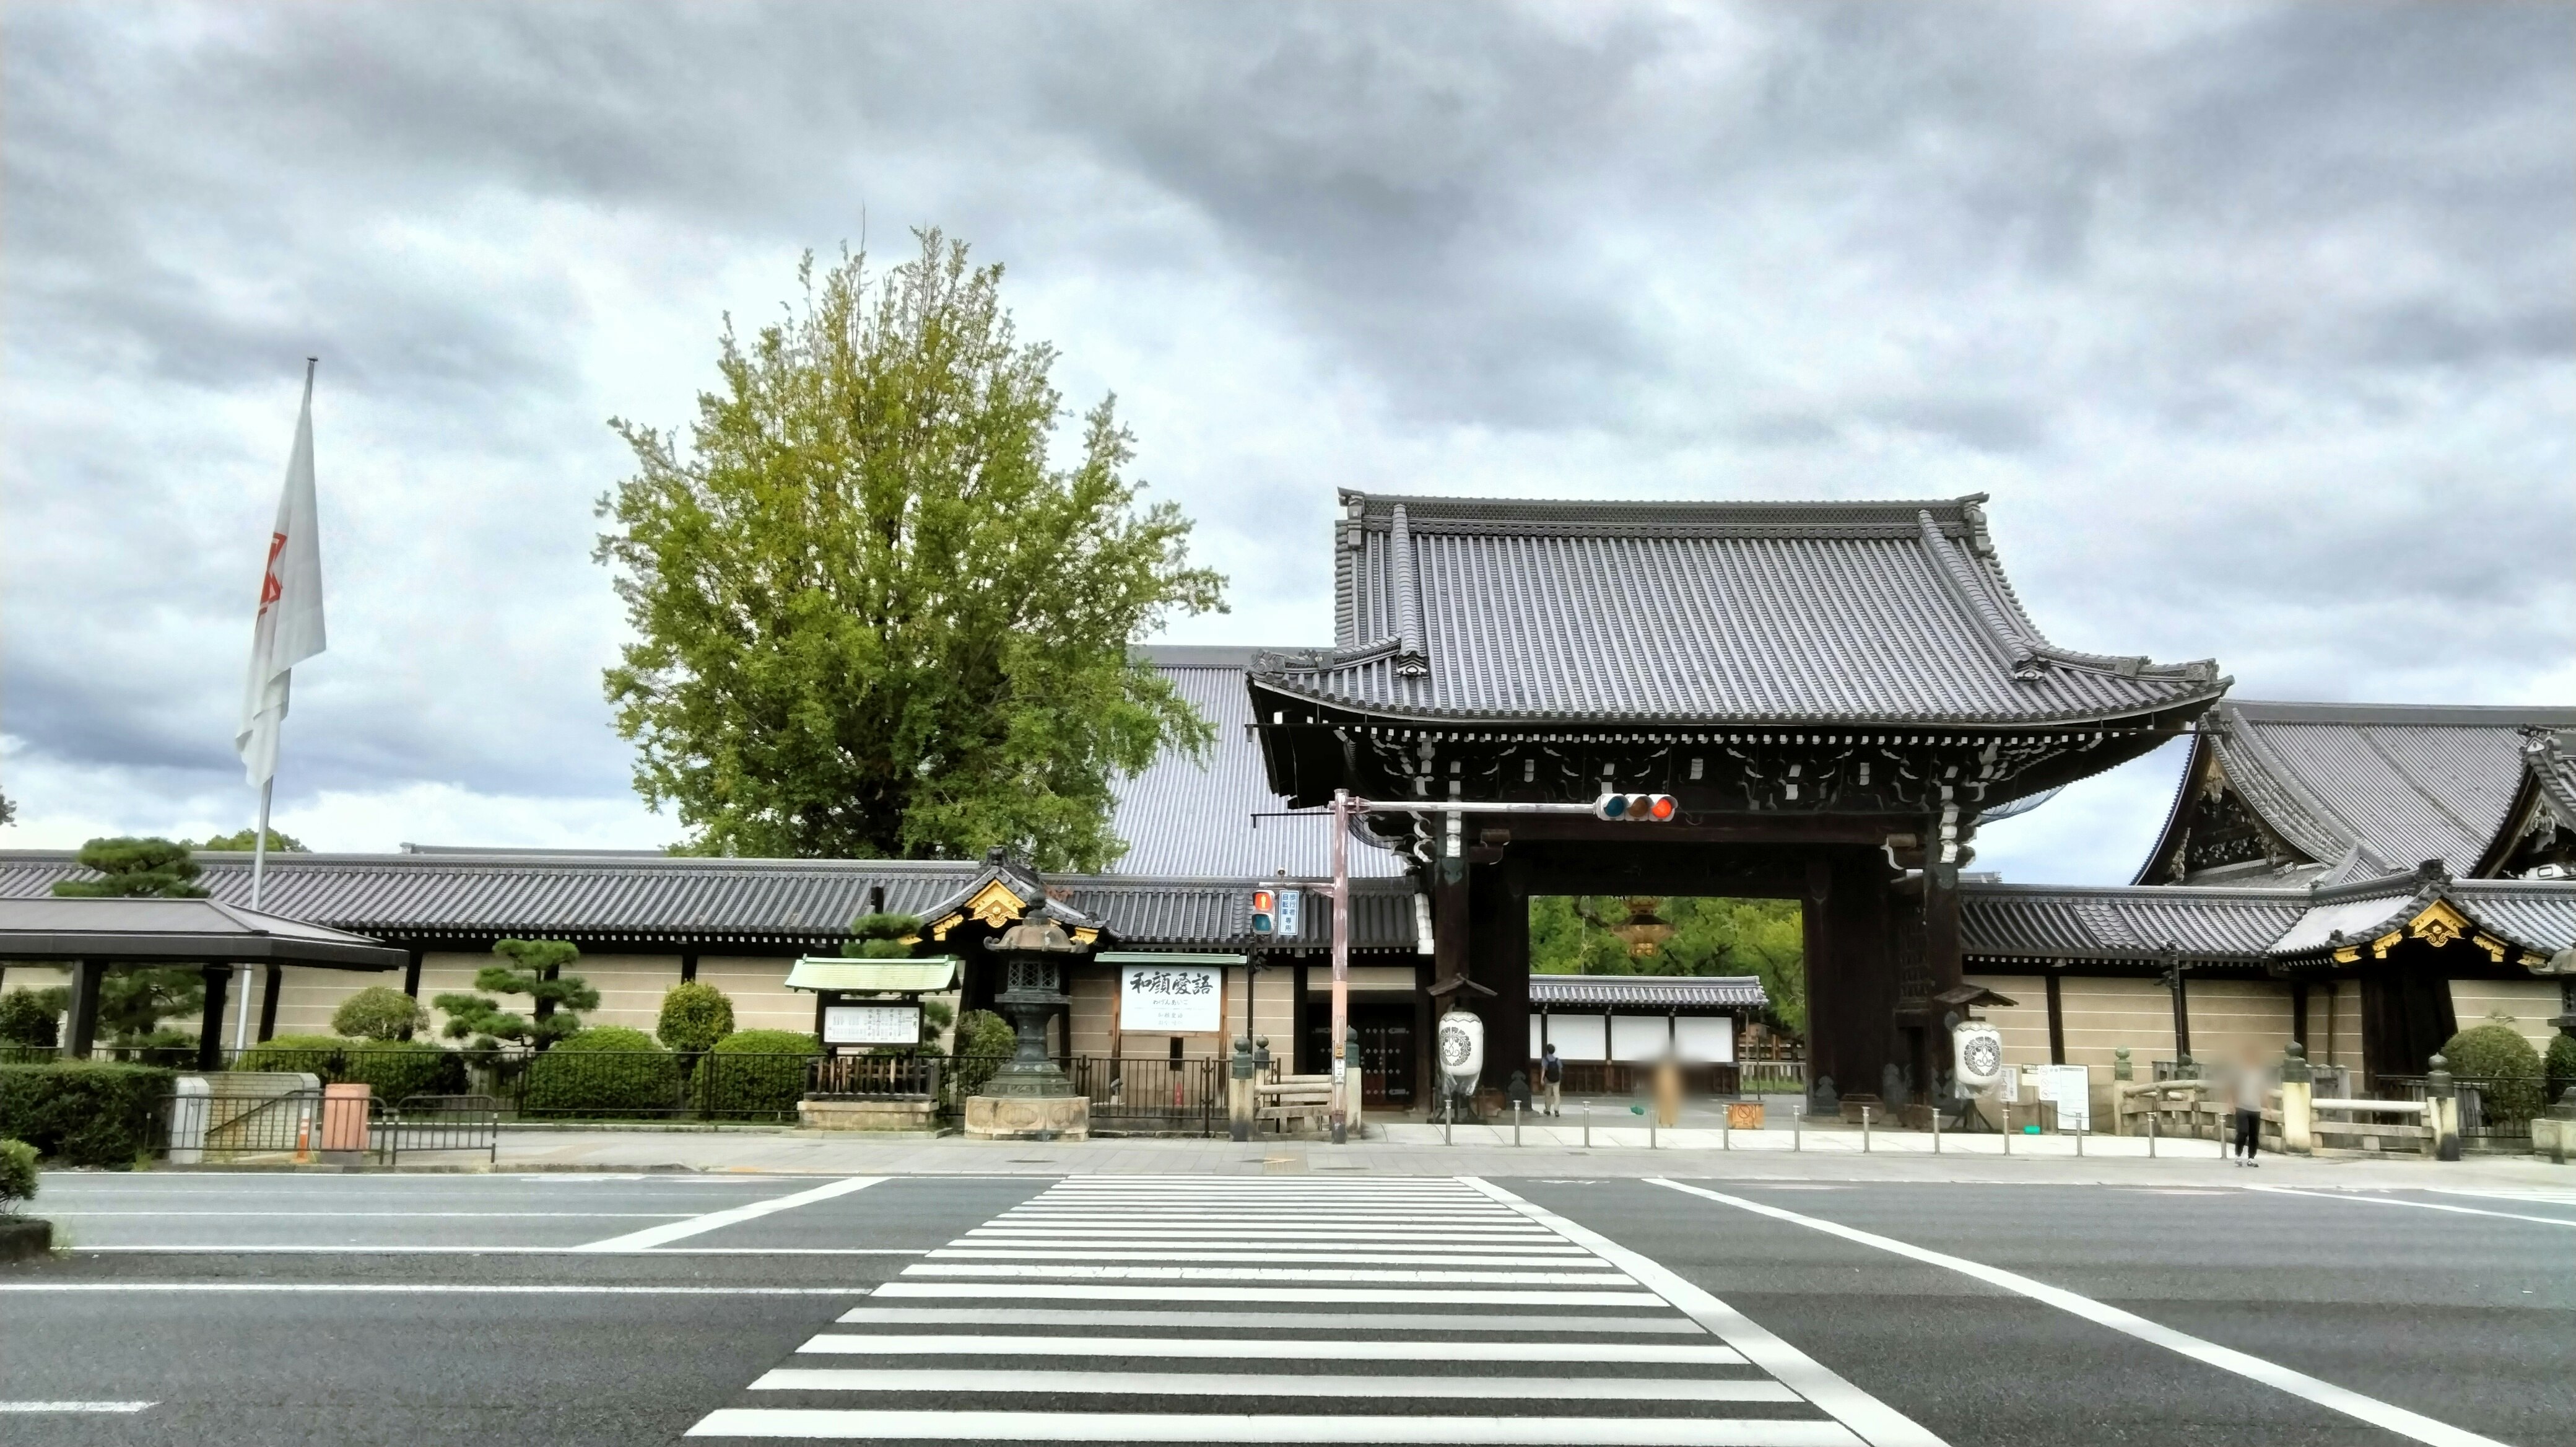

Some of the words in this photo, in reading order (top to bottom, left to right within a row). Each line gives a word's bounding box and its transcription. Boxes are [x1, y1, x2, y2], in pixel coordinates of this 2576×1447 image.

[1285, 917, 1292, 932] 専用
[1130, 971, 1213, 995] 和顔愛語
